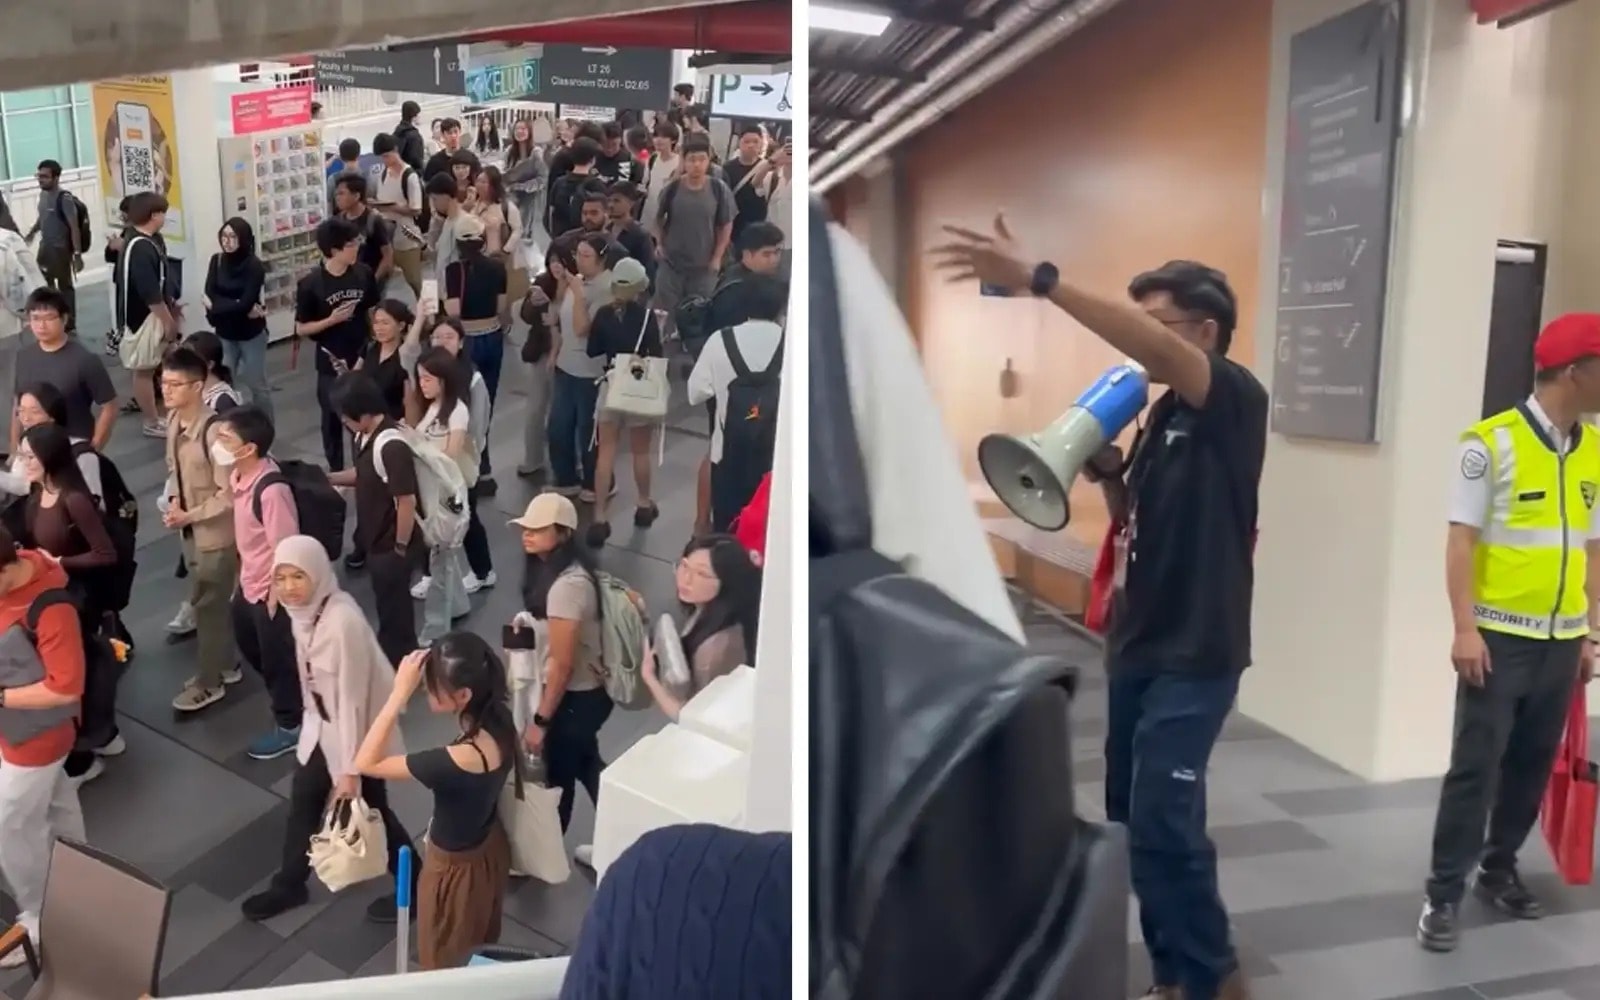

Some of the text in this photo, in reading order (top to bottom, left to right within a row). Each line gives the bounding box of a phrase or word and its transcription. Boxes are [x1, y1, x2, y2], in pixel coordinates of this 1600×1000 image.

[318, 61, 393, 75] Faculty of Innovation &
[588, 64, 611, 74] LT 26
[318, 70, 354, 83] Technology
[484, 64, 534, 98] KELUAR
[551, 75, 595, 88] Classroom
[719, 74, 742, 104] P
[1473, 605, 1543, 629] SECURITY
